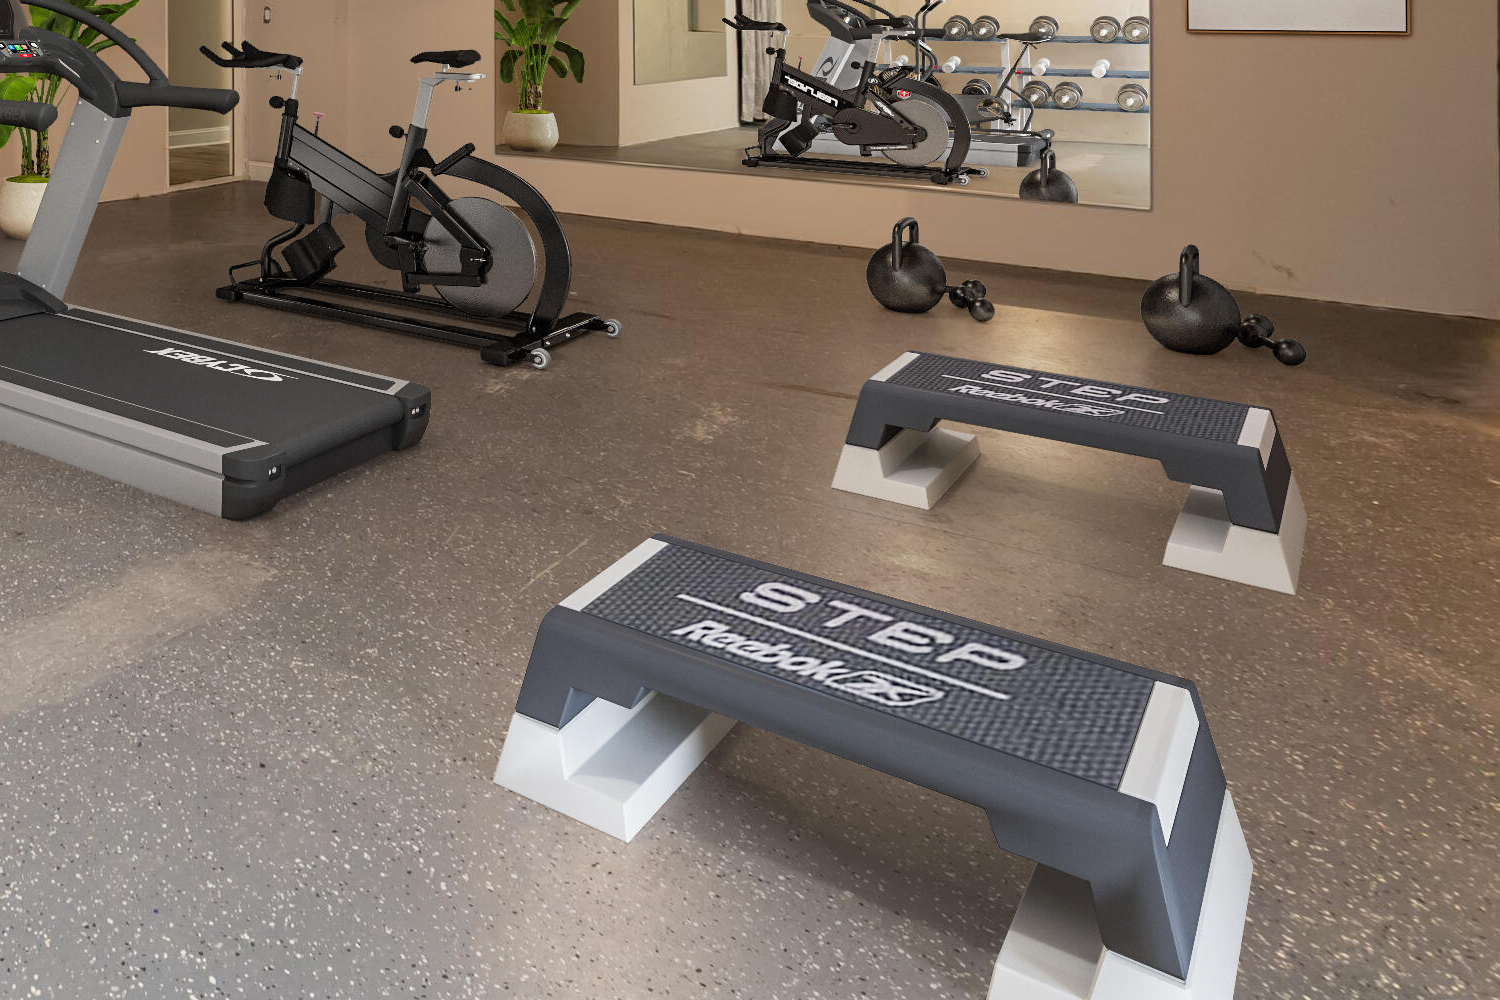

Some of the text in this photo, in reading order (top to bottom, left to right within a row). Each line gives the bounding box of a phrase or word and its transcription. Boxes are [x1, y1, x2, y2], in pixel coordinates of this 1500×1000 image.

[948, 384, 1063, 409] Reebok
[981, 369, 1170, 404] STEP
[671, 619, 852, 682] Reebok
[739, 582, 1027, 671] STEP
